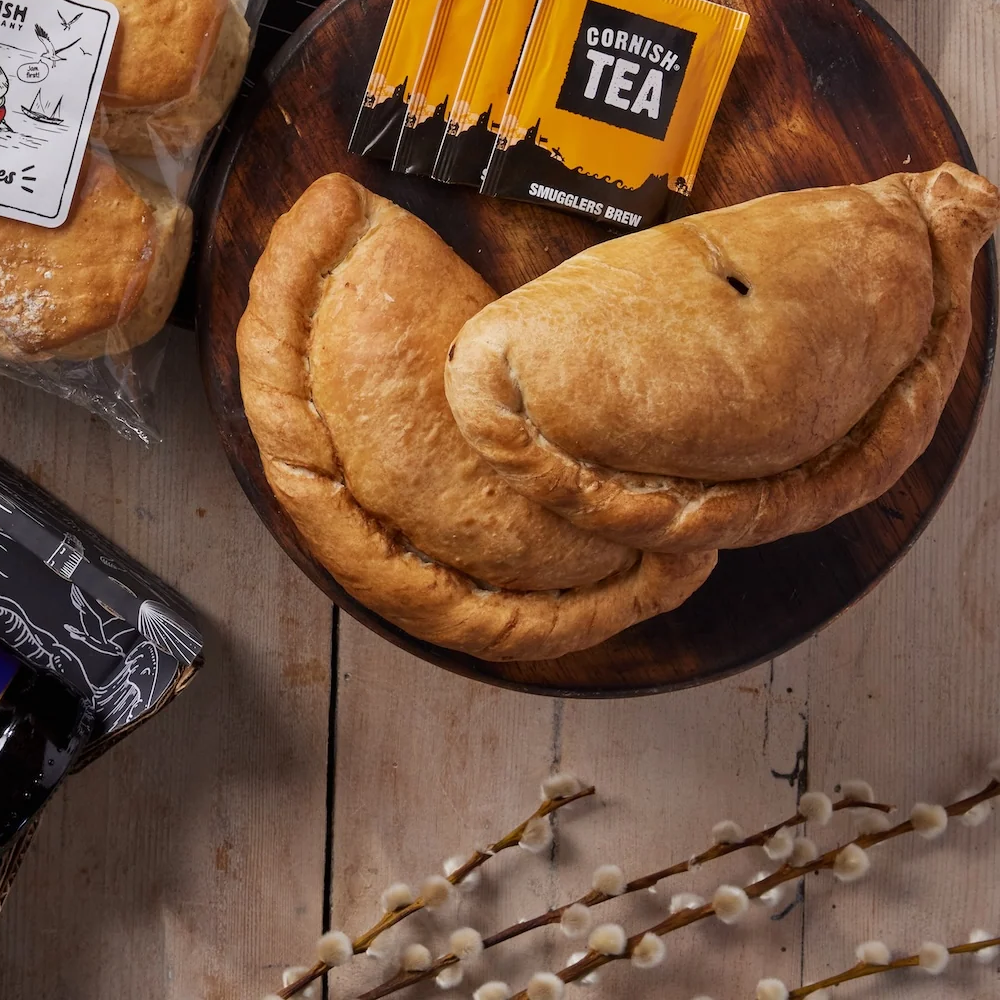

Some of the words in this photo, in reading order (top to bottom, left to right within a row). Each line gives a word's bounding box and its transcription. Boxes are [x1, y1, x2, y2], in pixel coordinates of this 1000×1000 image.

[583, 49, 665, 120] TEA
[528, 183, 604, 215] SMUGGLERS
[604, 203, 642, 228] BREW
